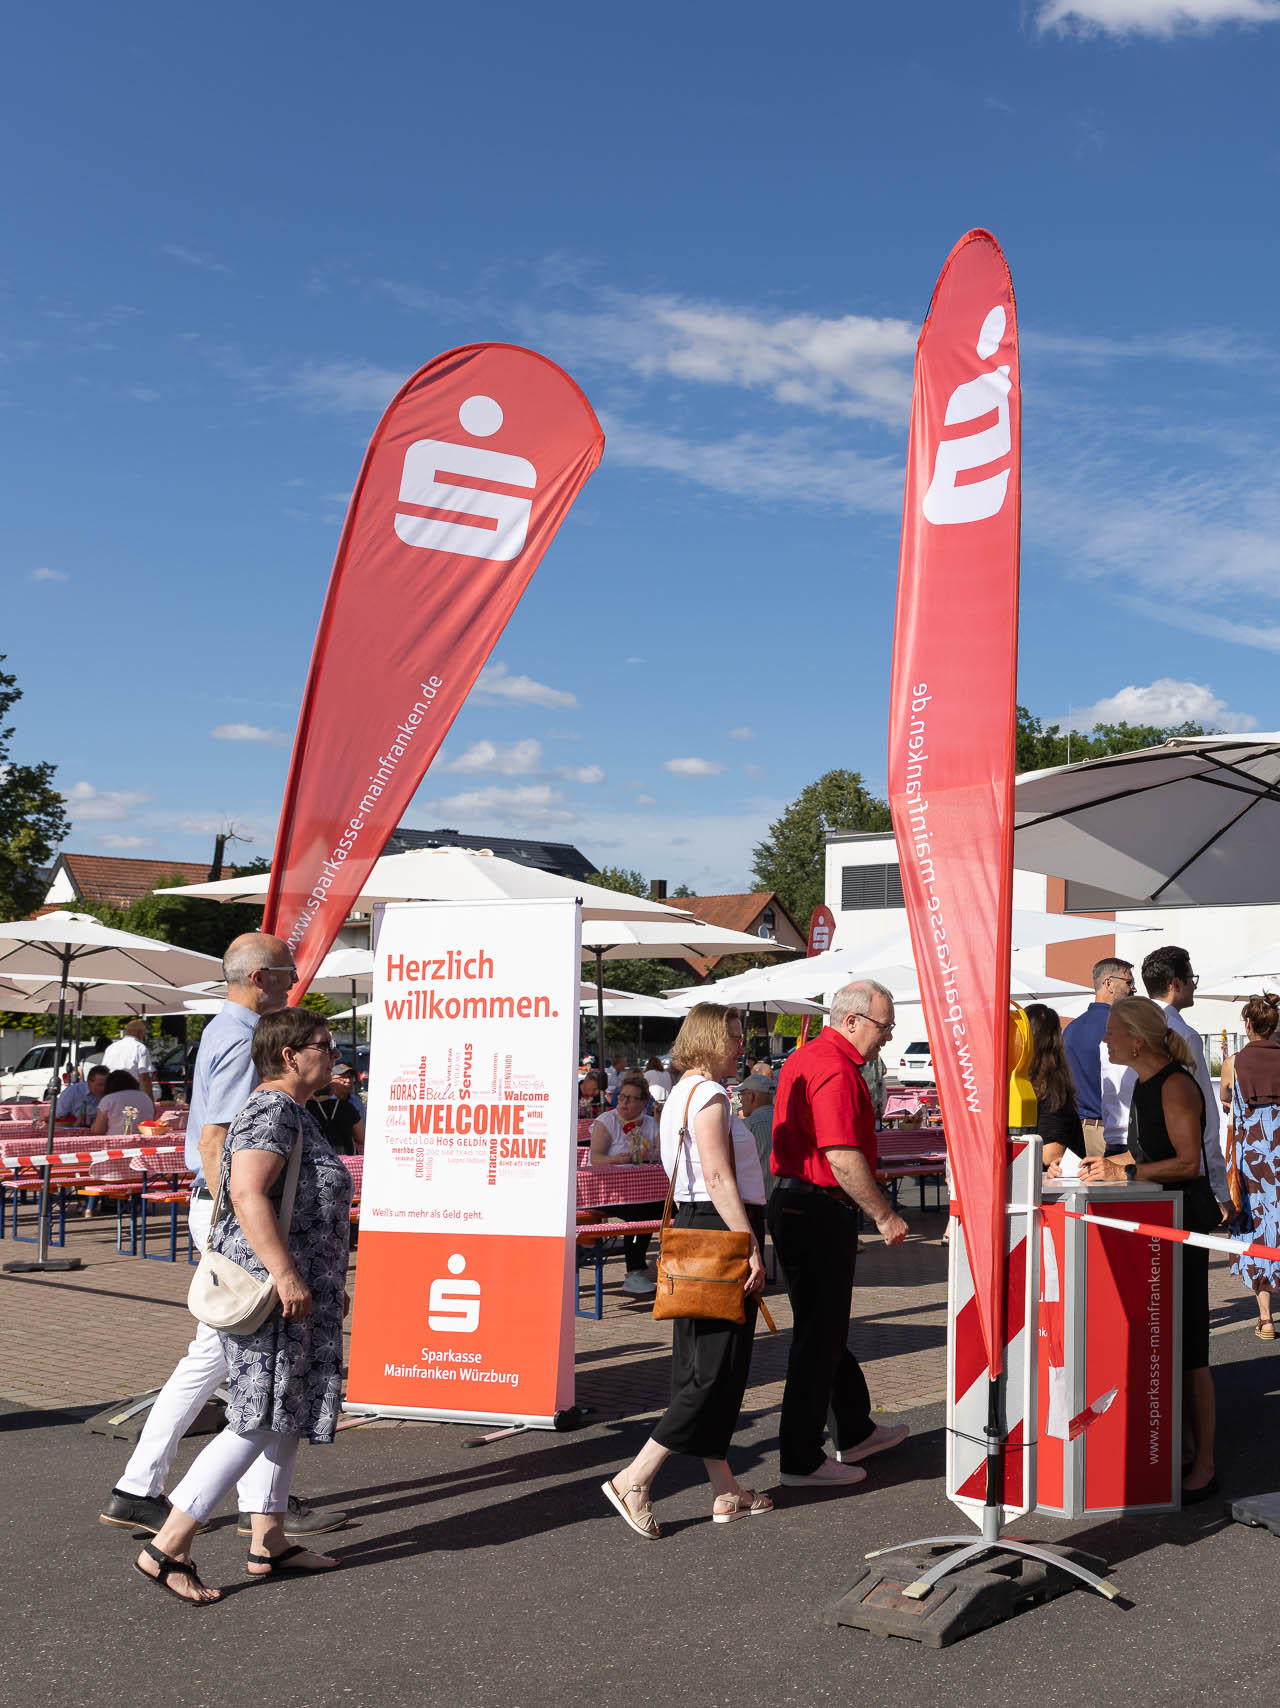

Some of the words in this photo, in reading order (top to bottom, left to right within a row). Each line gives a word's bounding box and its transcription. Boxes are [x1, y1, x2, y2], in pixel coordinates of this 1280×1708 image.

[287, 674, 444, 950] www.sparkasse-mainfranken.de
[386, 949, 494, 982] Herzlich
[384, 990, 559, 1020] willkommen.
[459, 1043, 473, 1100] Servus
[390, 1083, 417, 1101] HORAS
[427, 1083, 456, 1101] Bula
[504, 1090, 550, 1101] Walcome
[409, 1104, 525, 1135] WELCOME
[500, 1138, 546, 1159] SALVE
[416, 1147, 424, 1178] CROESO
[408, 1209, 428, 1218] mehr
[430, 1209, 440, 1218] als
[443, 1209, 461, 1219] Geld
[421, 1348, 482, 1364] Sparkasse
[384, 1364, 457, 1381] Mainfranken
[459, 1368, 519, 1387] Würzburg
